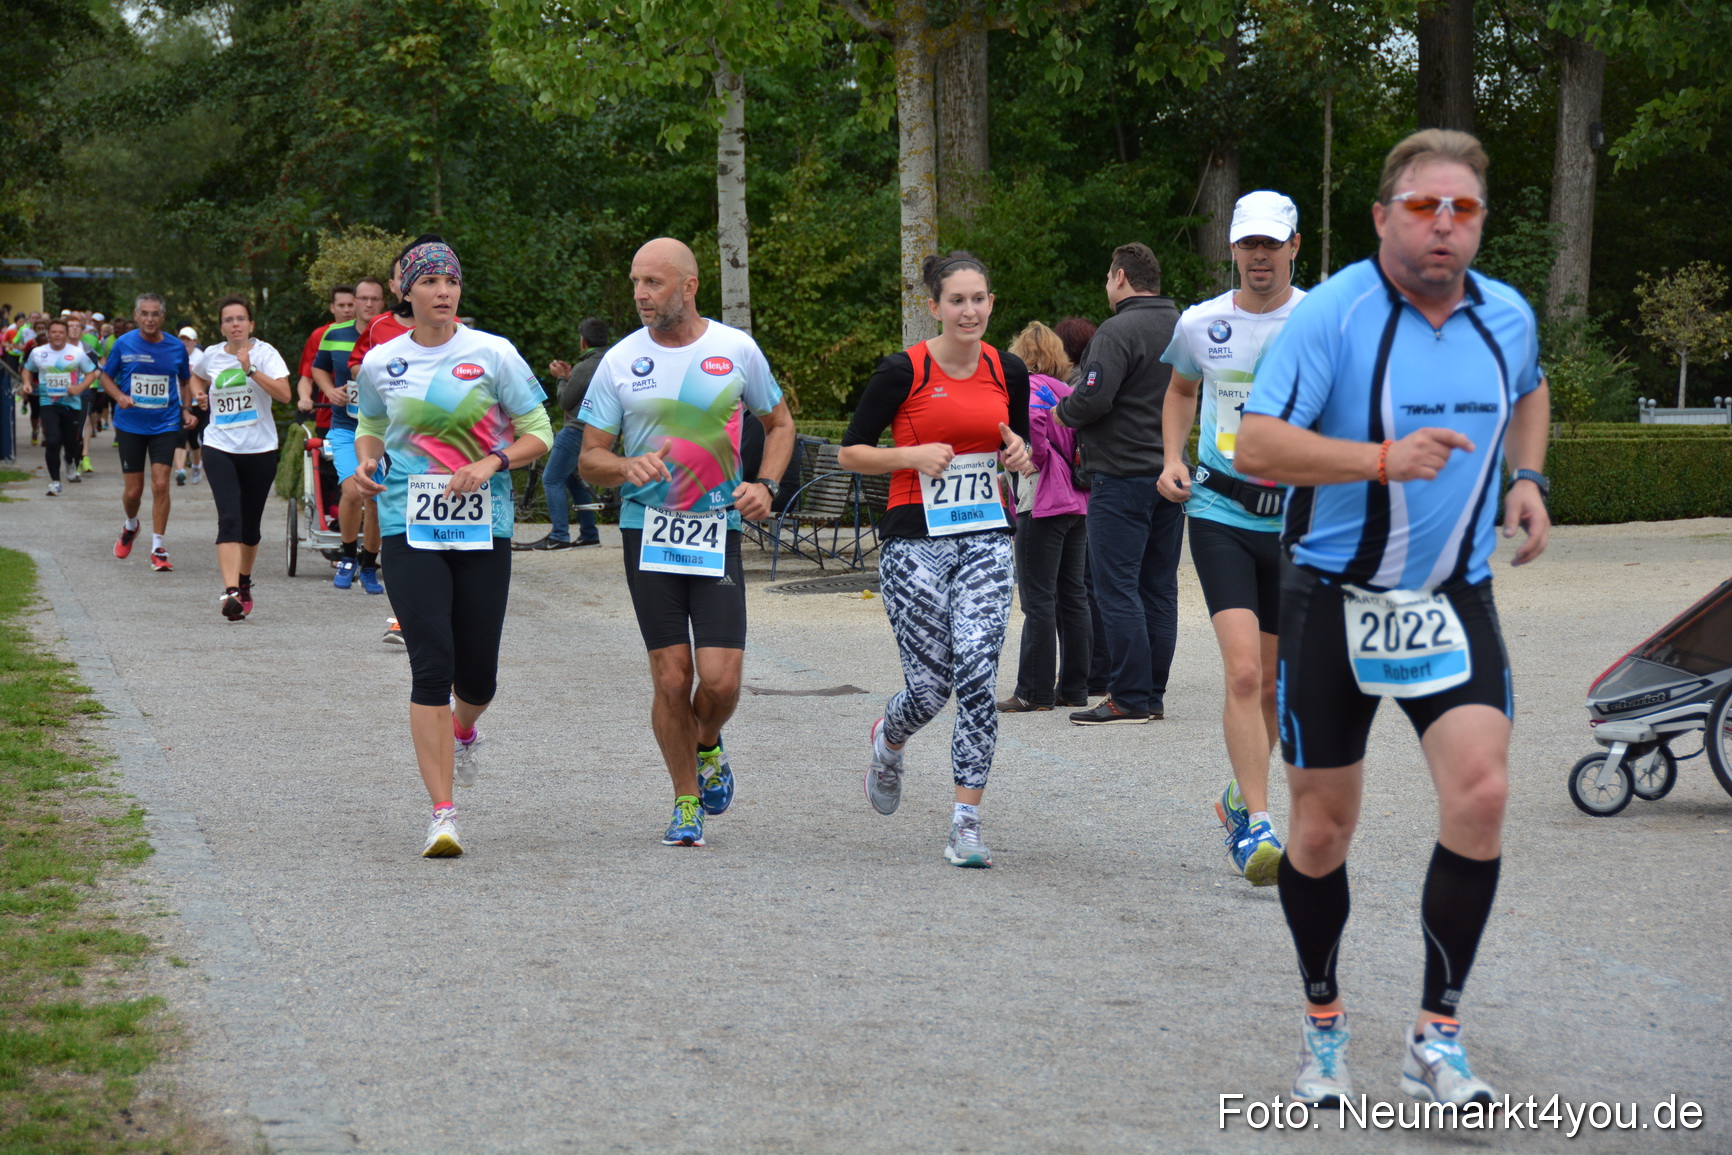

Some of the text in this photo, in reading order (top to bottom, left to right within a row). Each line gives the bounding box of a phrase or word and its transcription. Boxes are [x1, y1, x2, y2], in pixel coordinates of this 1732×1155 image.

[705, 361, 730, 371] Hervis
[48, 378, 69, 387] 2345
[135, 382, 166, 396] 3109
[632, 378, 657, 388] PARTL
[632, 384, 657, 392] Neumarkt
[1218, 389, 1244, 399] PARTL
[217, 395, 252, 412] 3012
[950, 461, 985, 472] Neumarkt
[410, 482, 436, 490] PARTL
[930, 472, 993, 505] 2773
[709, 490, 725, 504] 16.
[416, 493, 483, 521] 2623
[950, 510, 984, 522] Bianka
[433, 528, 465, 539] Katrin
[652, 515, 719, 548] 2624
[662, 550, 704, 565] Thomas
[1360, 609, 1453, 653] 2022
[1383, 661, 1432, 680] Robert
